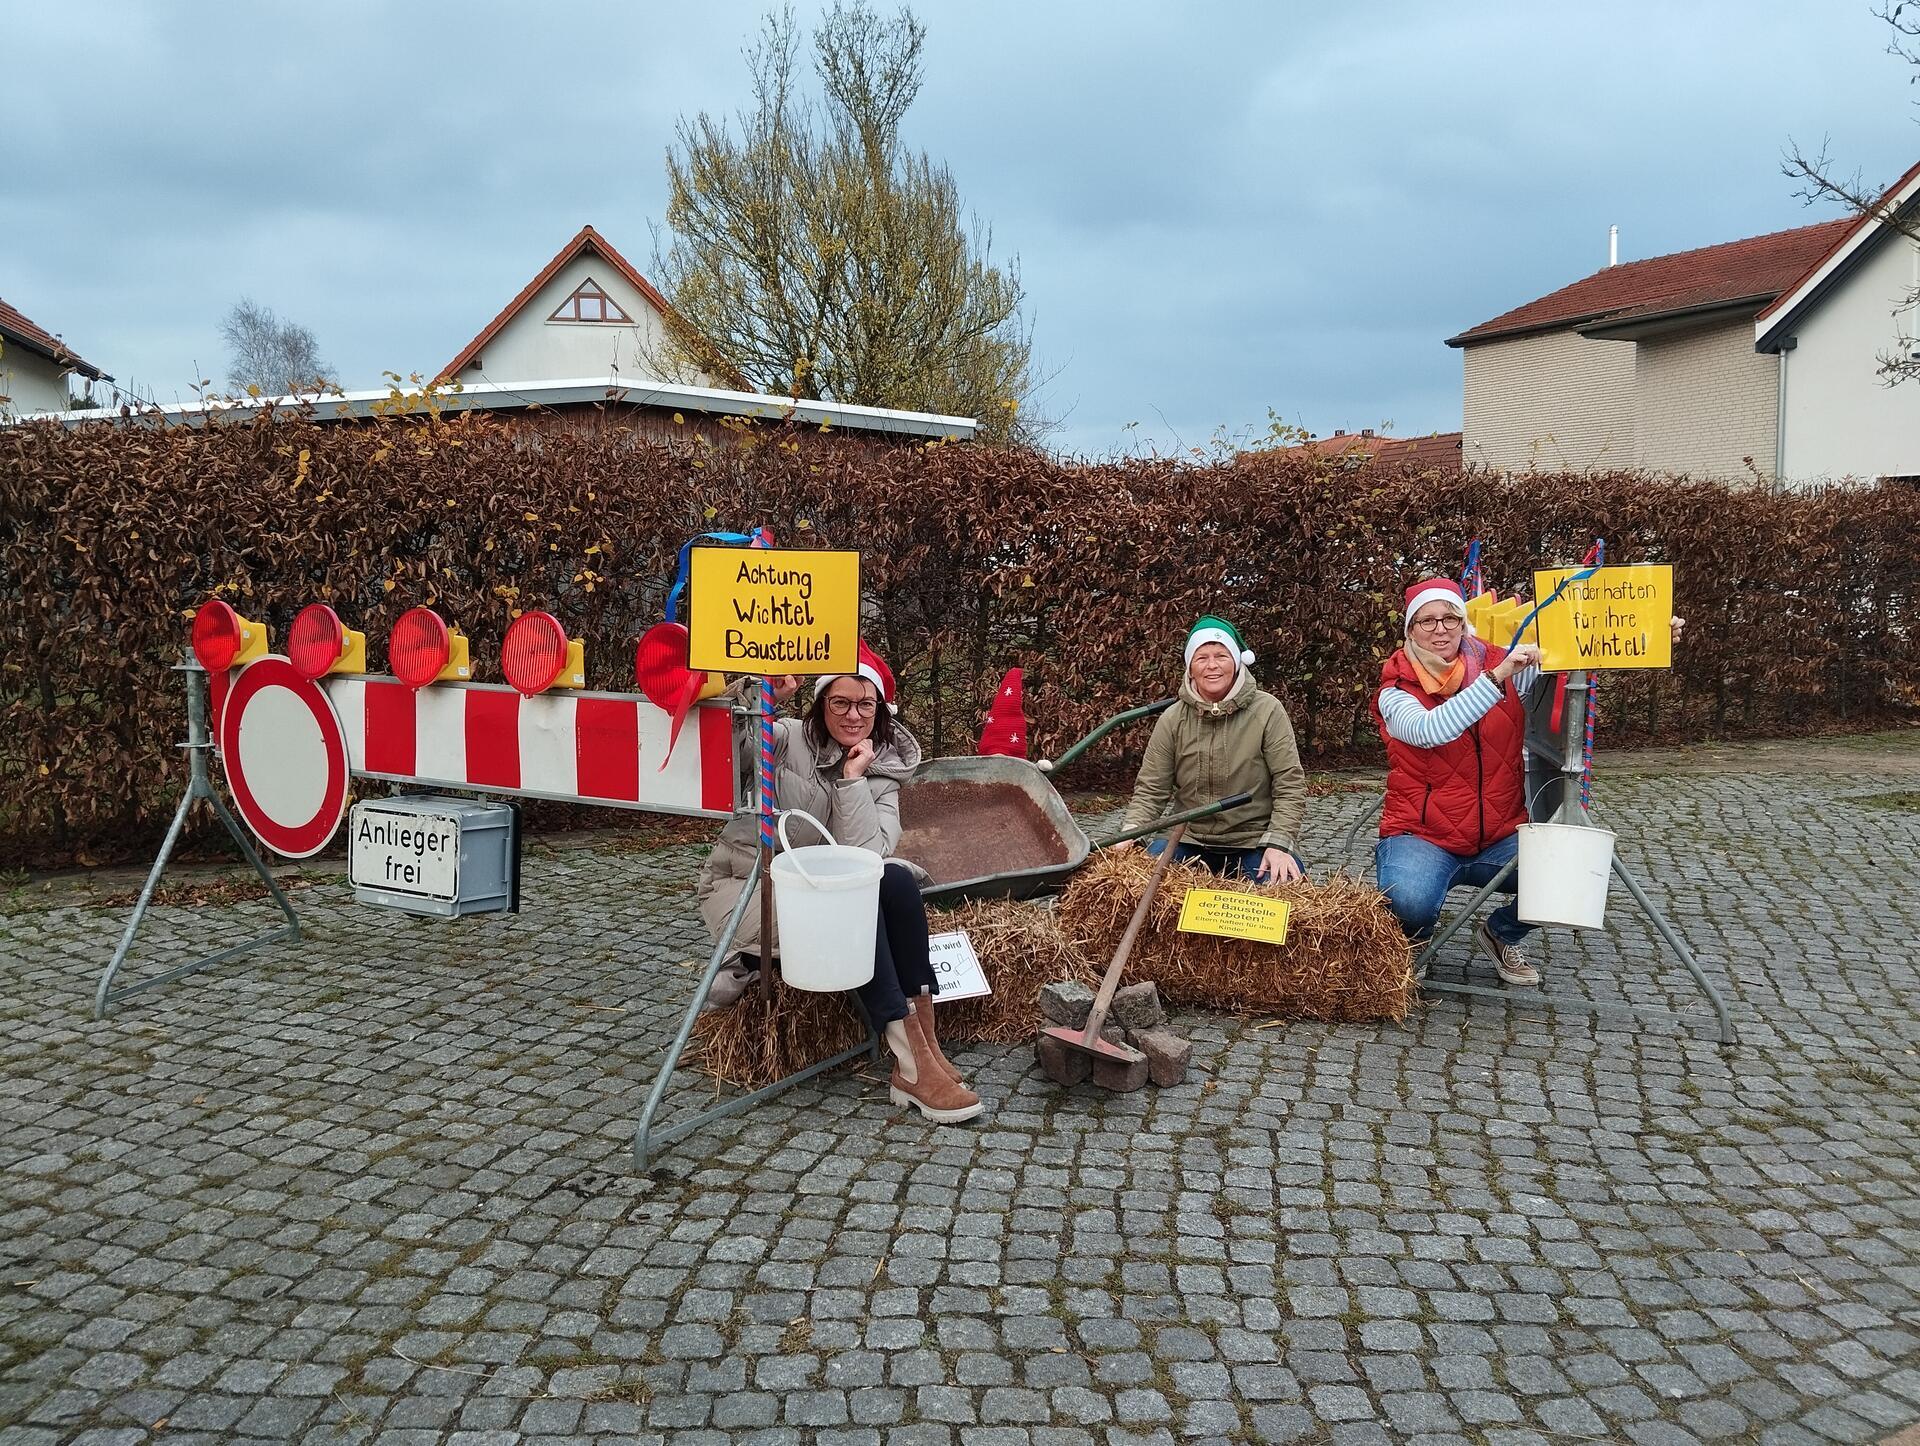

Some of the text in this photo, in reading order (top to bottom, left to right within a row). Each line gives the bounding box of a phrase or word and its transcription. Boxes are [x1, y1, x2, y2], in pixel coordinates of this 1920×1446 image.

[736, 560, 812, 599] Achtung
[1603, 578, 1657, 601] haften
[733, 595, 814, 626] Wichtel
[1573, 605, 1636, 629] für ihre
[725, 629, 830, 662] Baustelle!
[1575, 633, 1646, 657] Wichtel!
[358, 818, 450, 856] Anlieger
[385, 855, 421, 884] frei
[1198, 901, 1277, 917] der Baustelle
[1214, 894, 1264, 908] Betreten
[1207, 910, 1265, 923] verboten!
[1246, 921, 1257, 929] für
[1218, 925, 1248, 933] Kinder!
[928, 940, 962, 953] ch wird
[930, 961, 951, 974] EO
[939, 979, 962, 991] acht!
